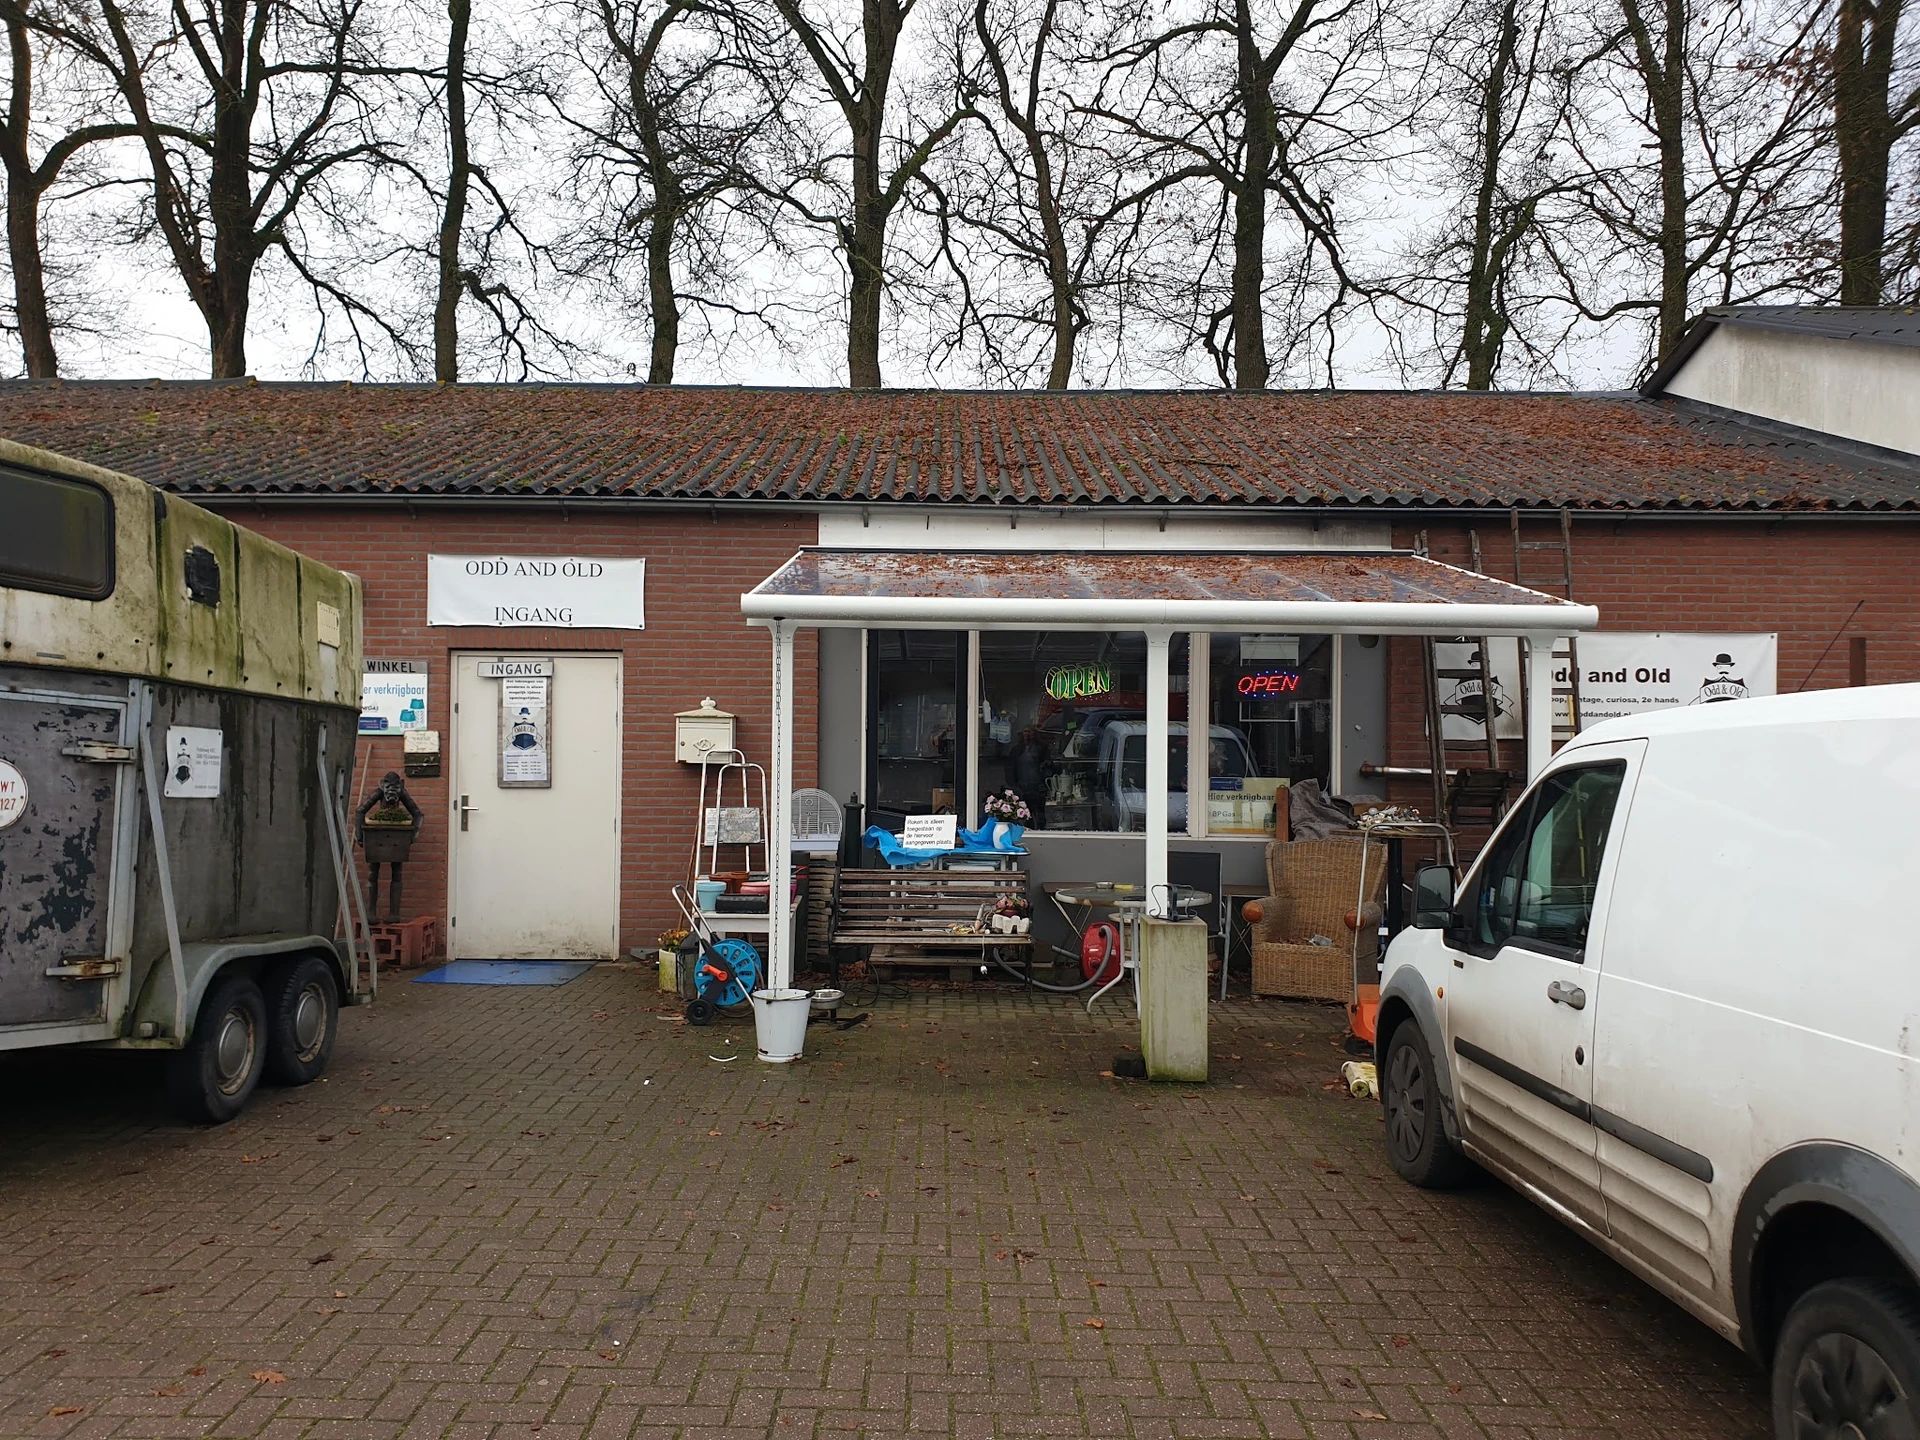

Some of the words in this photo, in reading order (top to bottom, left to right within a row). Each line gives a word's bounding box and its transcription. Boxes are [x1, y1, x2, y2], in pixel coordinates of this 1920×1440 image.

[466, 560, 508, 576] ODD
[514, 562, 556, 577] AND
[562, 562, 603, 578] OLD
[494, 606, 573, 623] INGANG
[366, 660, 416, 673] WINKEL
[491, 664, 542, 674] INGANG
[1045, 662, 1110, 700] OPEN
[1588, 668, 1627, 683] and
[1635, 668, 1670, 683] Old
[363, 686, 372, 694] er
[374, 683, 425, 697] verkrijgbaar
[1238, 676, 1300, 692] OPEN
[1460, 682, 1476, 694] Odd
[1704, 685, 1720, 697] Odd
[1722, 684, 1728, 694] &
[1730, 685, 1744, 698] Old
